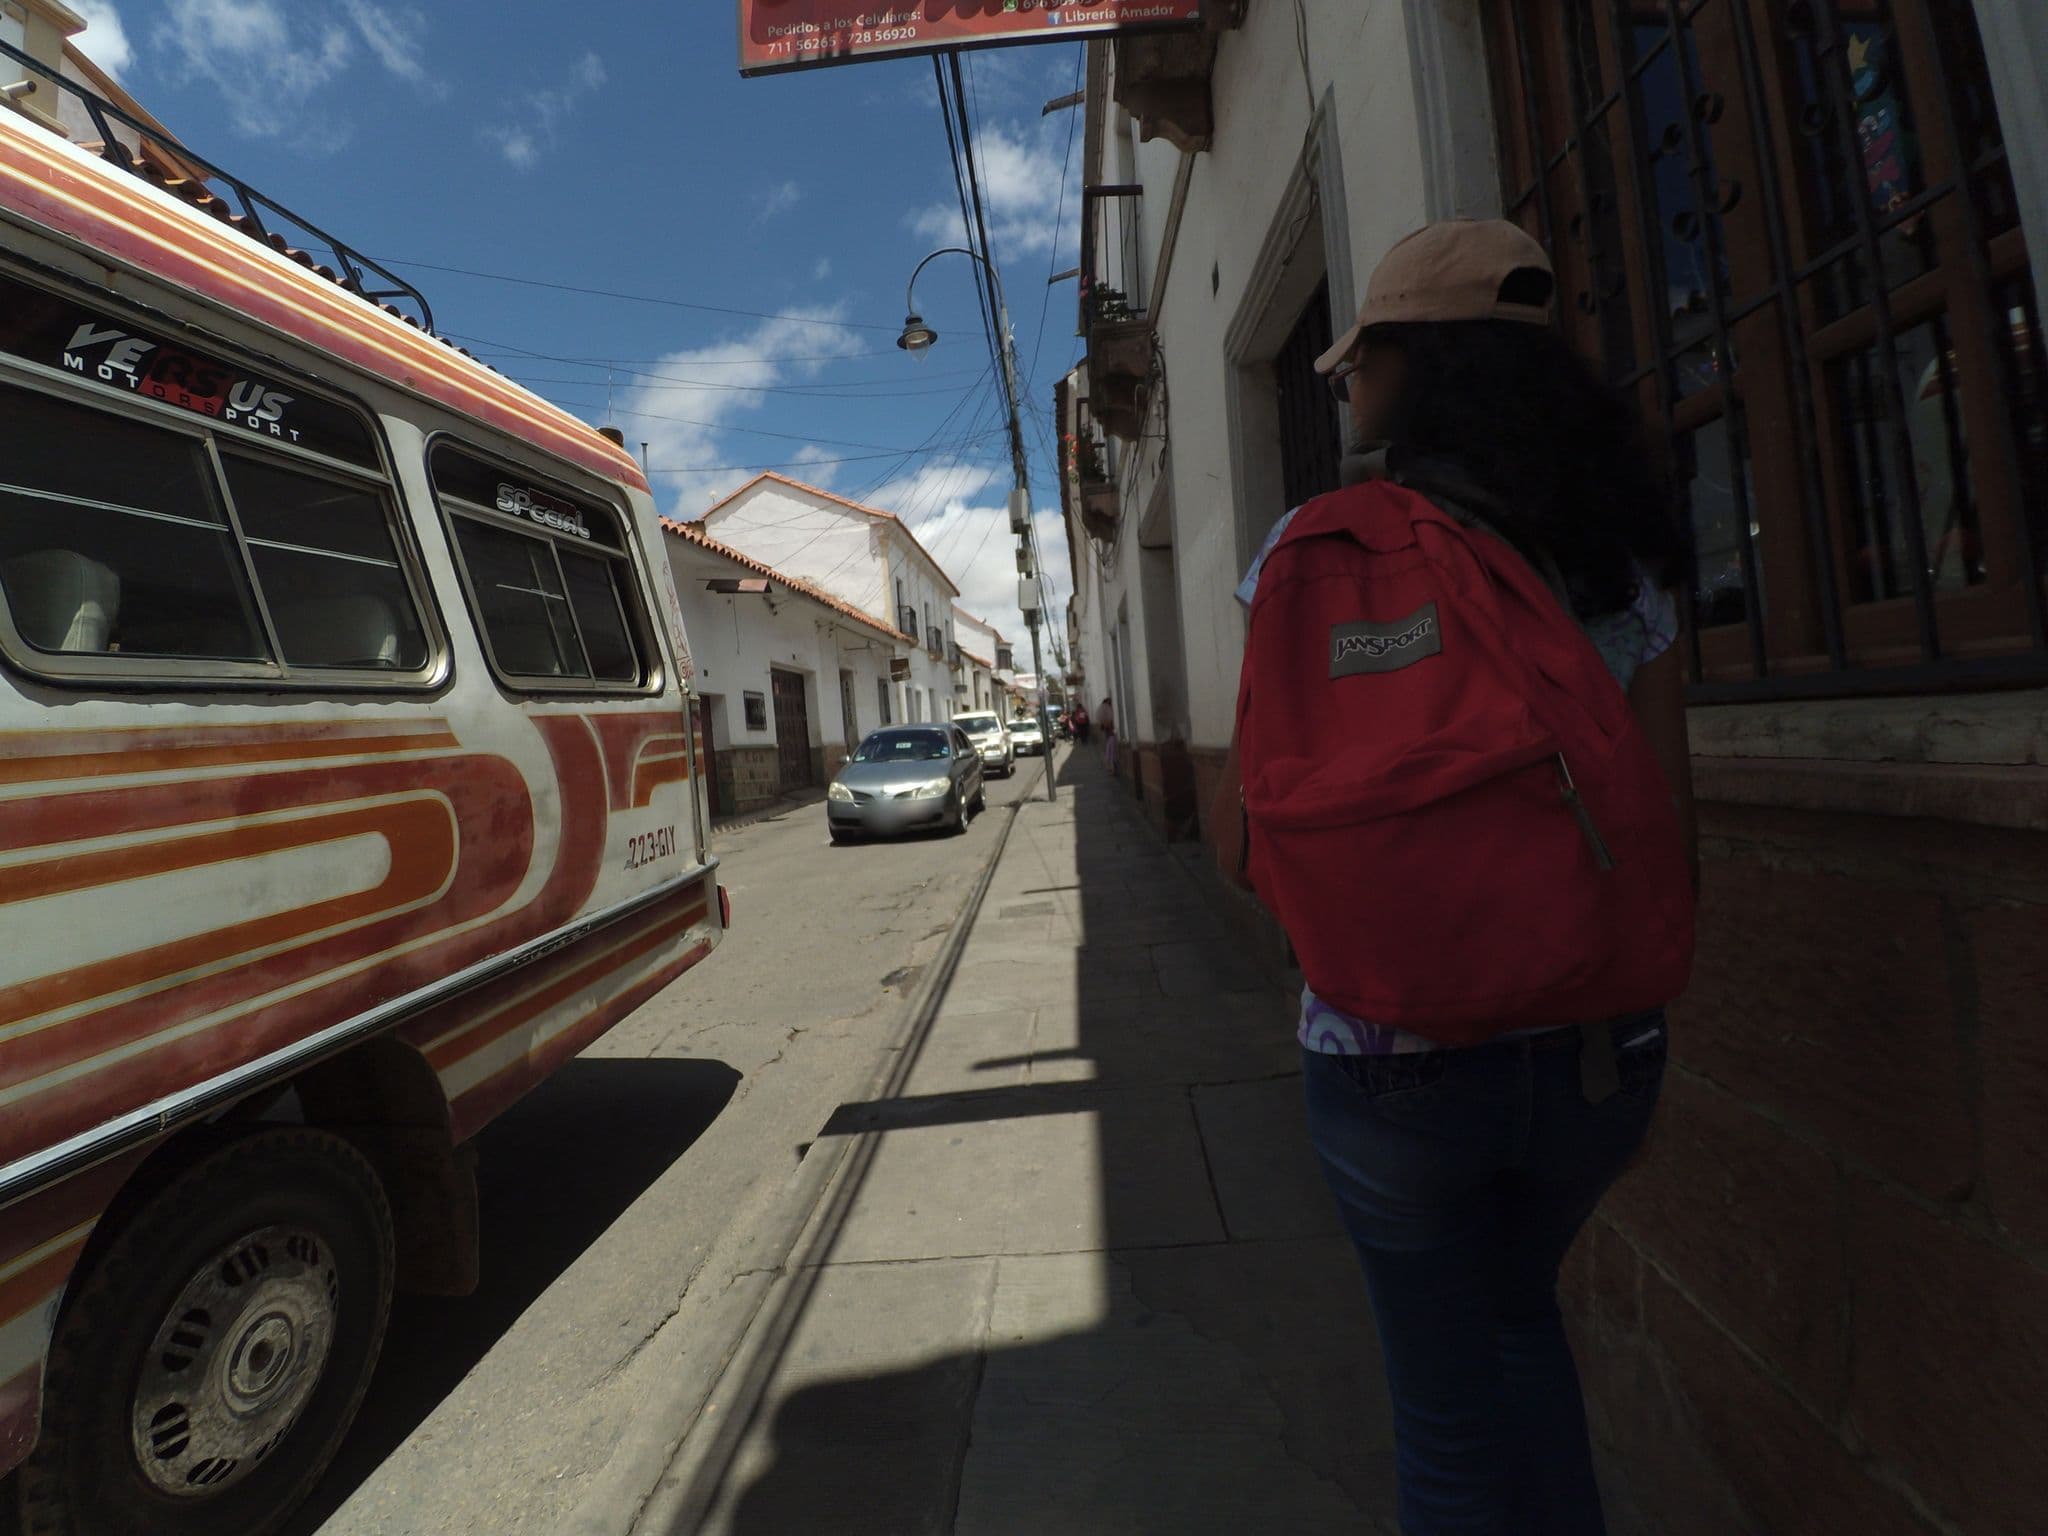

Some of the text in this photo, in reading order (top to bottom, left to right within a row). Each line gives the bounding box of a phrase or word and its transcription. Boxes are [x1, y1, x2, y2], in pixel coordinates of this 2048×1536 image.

[767, 7, 921, 37] Pedidos a los Celulares:
[1065, 8, 1116, 23] Librería
[1120, 4, 1174, 18] Amador
[767, 26, 916, 55] 711 56265 728 56920
[64, 322, 296, 422] VERSUS
